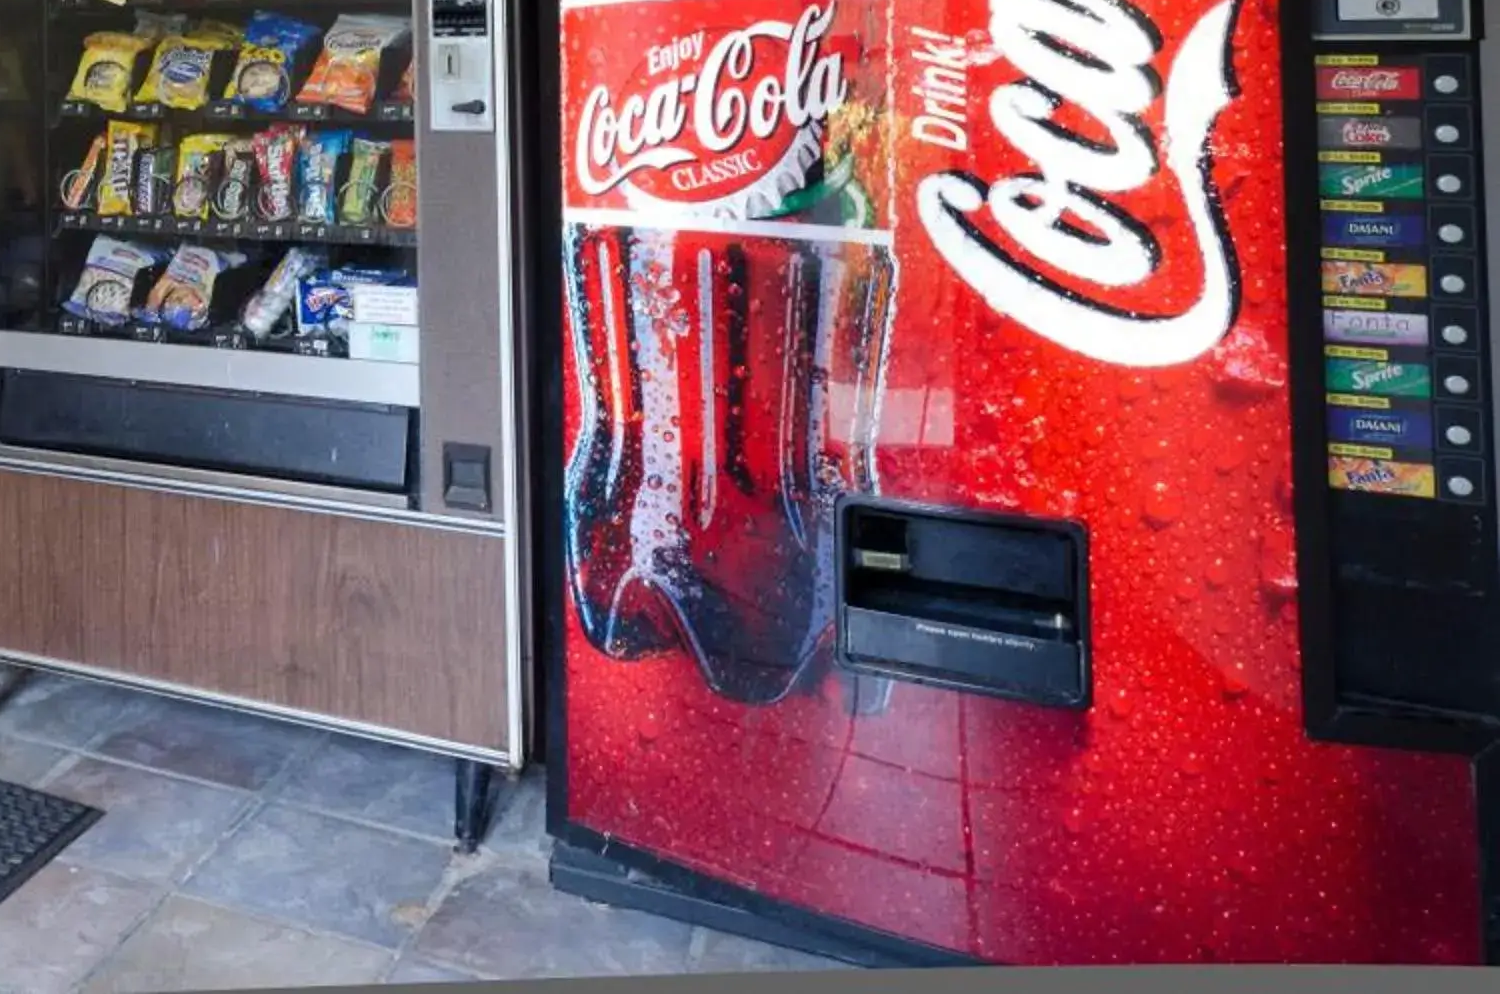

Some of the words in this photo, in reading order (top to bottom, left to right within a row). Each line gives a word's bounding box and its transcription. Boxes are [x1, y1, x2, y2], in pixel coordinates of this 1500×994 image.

[646, 31, 704, 76] Enjoy
[911, 26, 968, 151] Drink!
[1332, 70, 1400, 91] Coca-Cola
[575, 0, 848, 196] Coca-Cola
[671, 148, 762, 192] CLASSIC
[1341, 165, 1392, 196] Sprite
[1348, 223, 1394, 235] DASANI
[1331, 312, 1410, 332] Fanta
[1352, 363, 1404, 390] Sprite
[1355, 418, 1402, 435] DASANI
